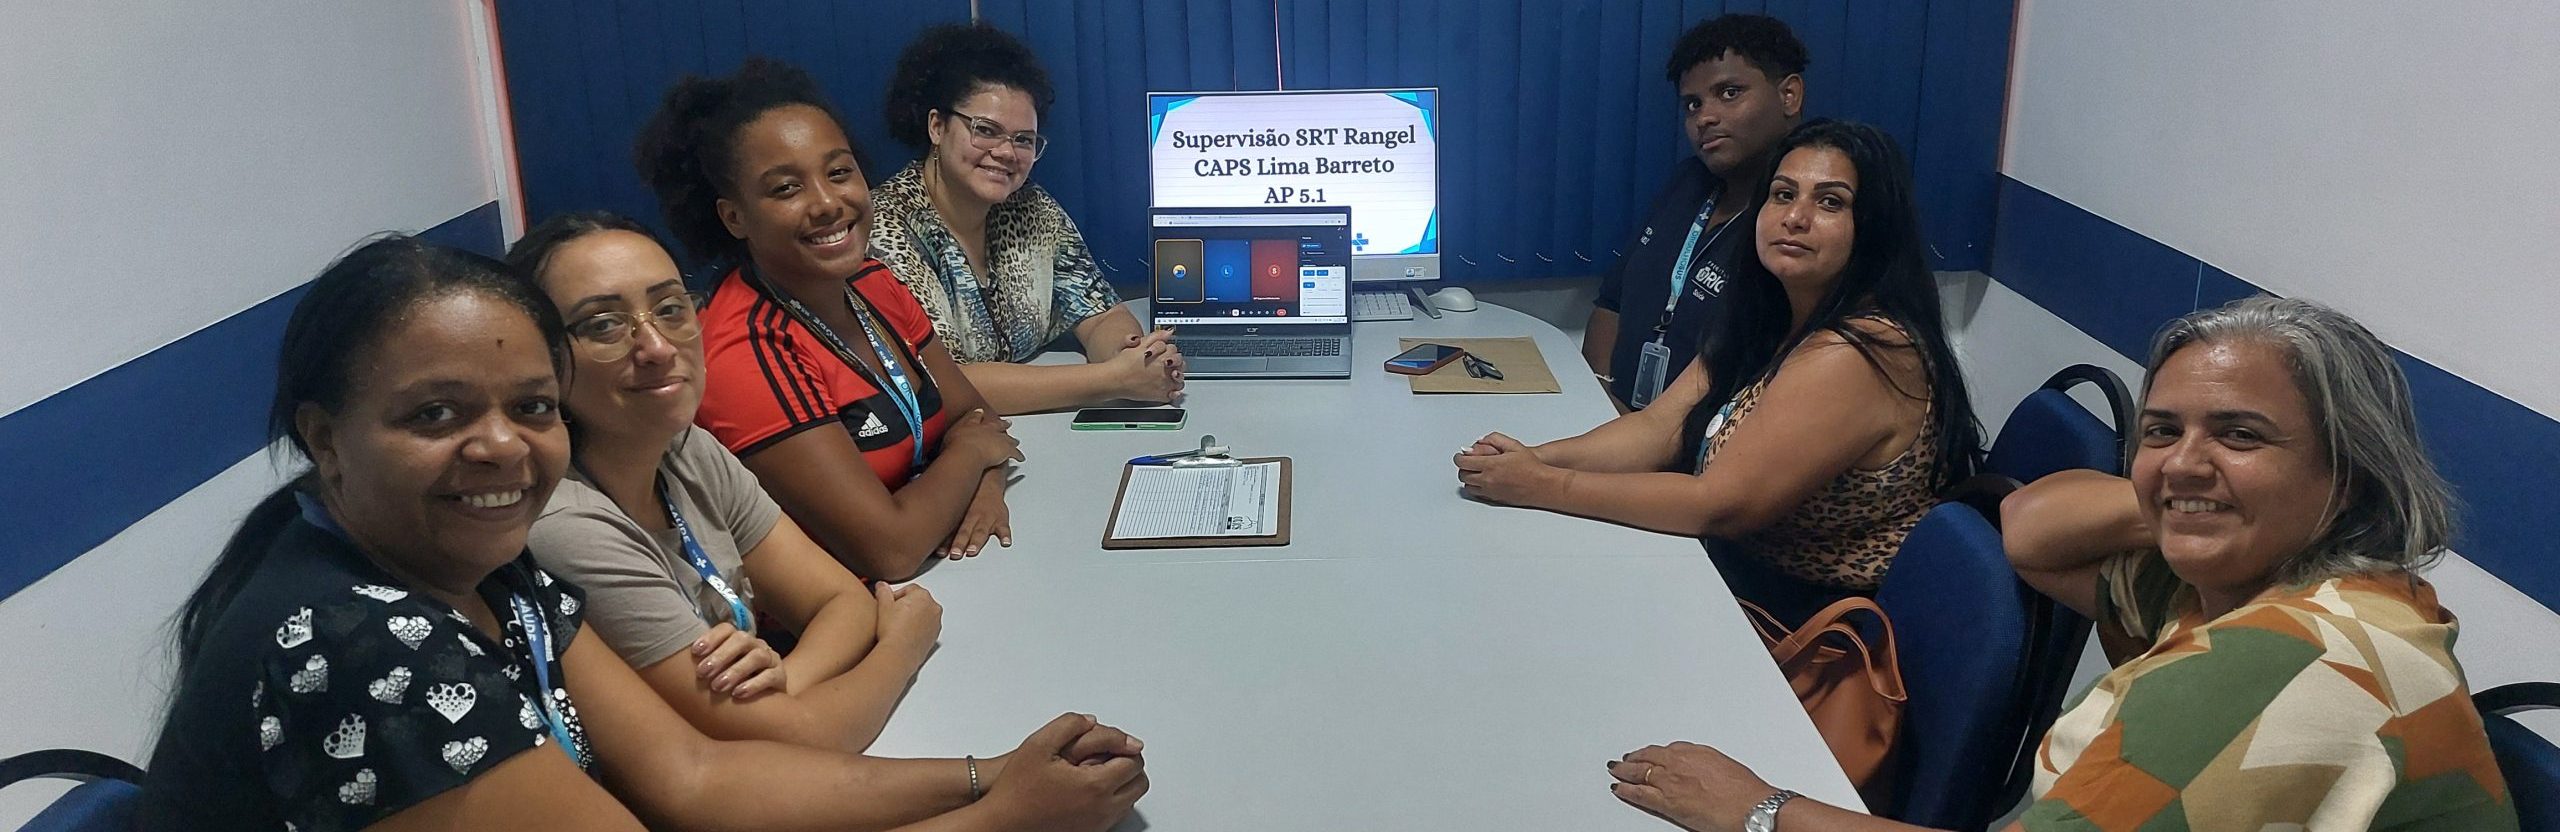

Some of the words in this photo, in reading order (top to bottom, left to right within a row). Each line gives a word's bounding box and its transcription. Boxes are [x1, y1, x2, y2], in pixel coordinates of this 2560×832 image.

[1173, 129, 1290, 152] Supervisão
[1296, 129, 1338, 147] SRT
[1344, 125, 1416, 148] Rangel
[1194, 159, 1251, 177] CAPS
[1257, 157, 1310, 176] Lima
[1315, 157, 1394, 175] Barreto
[1264, 187, 1294, 204] AP
[1299, 188, 1326, 203] 5.1
[858, 424, 888, 438] adidas
